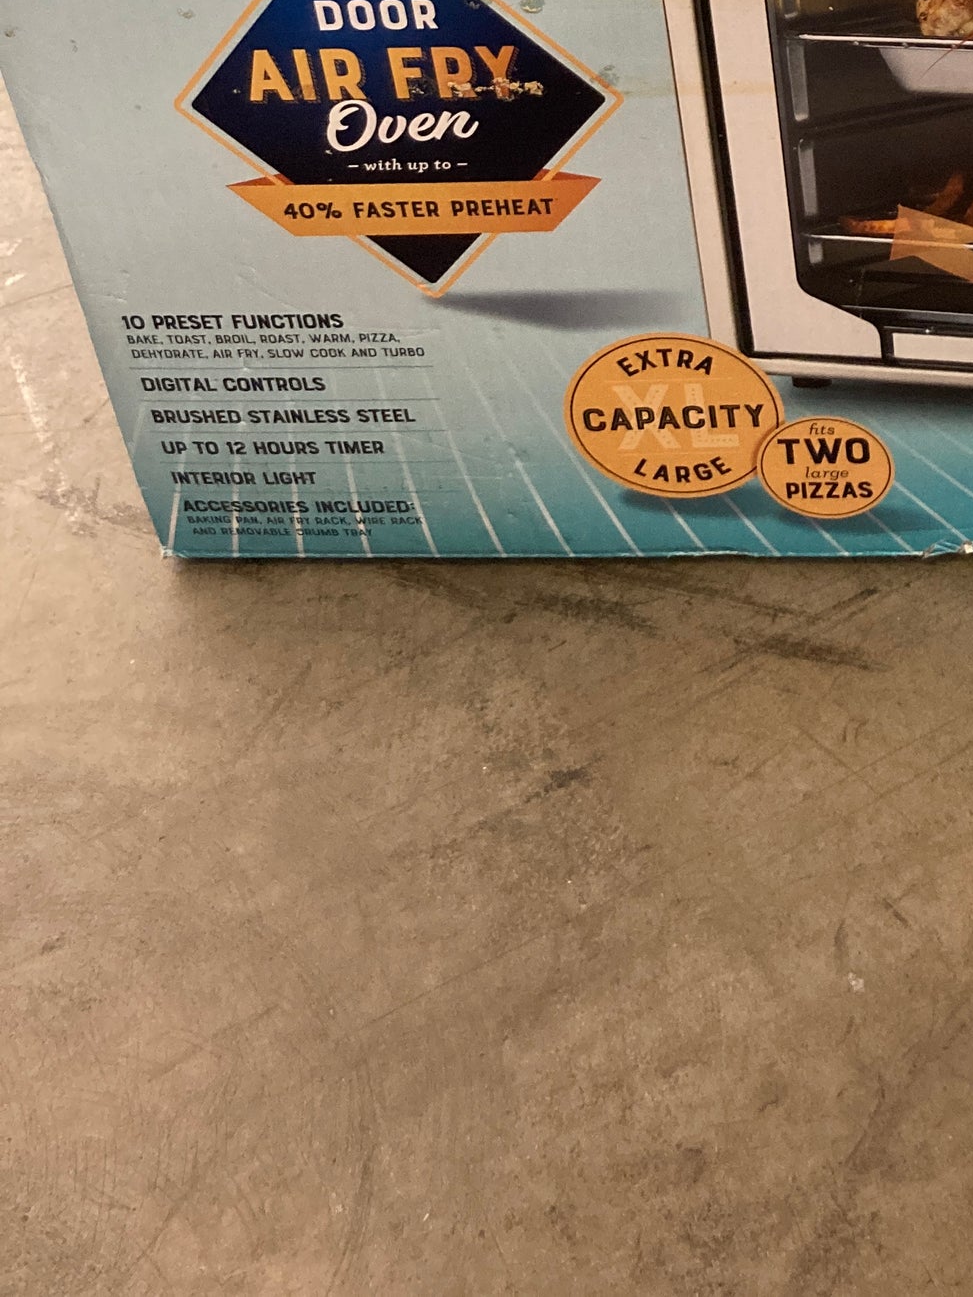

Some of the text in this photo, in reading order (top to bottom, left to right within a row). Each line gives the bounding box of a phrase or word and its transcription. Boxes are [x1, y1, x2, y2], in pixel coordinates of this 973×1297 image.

[249, 44, 520, 103] AIR FRY
[326, 99, 479, 152] Oven
[364, 157, 452, 175] with up to
[283, 197, 554, 220] 40% FASTER PREHEAT
[121, 313, 344, 330] 10 PRESET FUNCTIONS
[127, 332, 401, 346] BAKE, TOAST, BROIL, ROAST, WARM, PIZZA,
[131, 346, 426, 360] DEHYDRATE, AIR FRY, SLOW COOK AND TURBO
[616, 348, 714, 377] EXTRA
[140, 376, 327, 392] DIGITAL CONTROLS
[151, 408, 416, 424] BRUSHED STAINLESS STEEL
[582, 403, 765, 432] CAPACITY
[808, 422, 835, 436] fits
[160, 440, 385, 455] UP TO 12 HOURS TIMER
[776, 437, 872, 465] TWO
[633, 455, 733, 484] LARGE
[804, 466, 849, 480] large
[170, 471, 317, 486] INTERIOR LIGHT
[785, 481, 874, 499] PIZZAS
[183, 500, 416, 514] ACCESSORIES INCLUDED:
[187, 515, 232, 525] BAKING
[266, 515, 286, 525] AIR
[289, 515, 311, 525] FRY
[355, 515, 387, 525] WIRE
[390, 515, 424, 525] RACK
[193, 527, 217, 536] AND
[220, 527, 291, 536] REMOVABLE
[343, 527, 373, 536] TRAY
